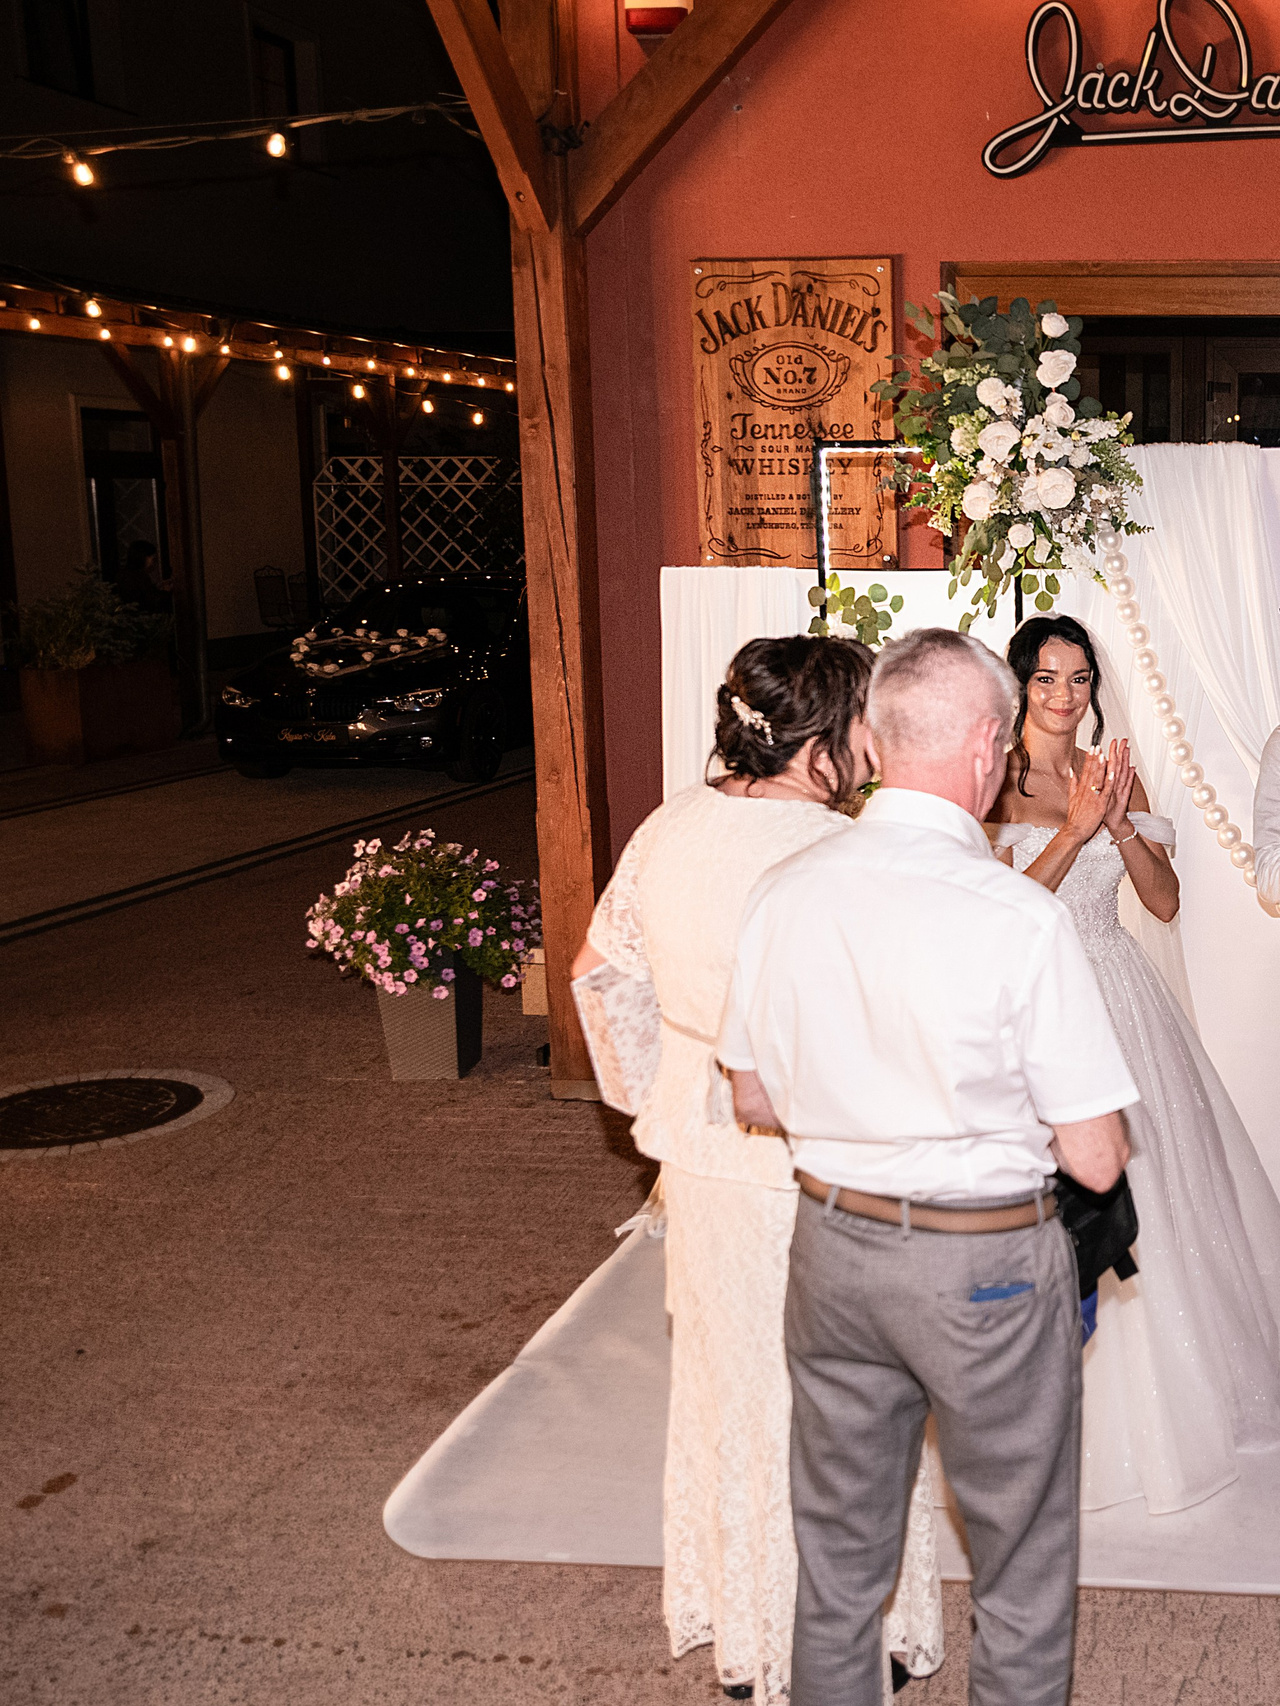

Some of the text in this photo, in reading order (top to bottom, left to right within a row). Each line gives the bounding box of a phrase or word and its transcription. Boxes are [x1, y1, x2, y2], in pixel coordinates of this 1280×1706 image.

[982, 0, 1168, 176] Jack
[694, 281, 889, 355] JACK DANIEL'S
[776, 355, 804, 365] Old
[730, 412, 855, 440] Tennessee
[760, 445, 790, 453] SOUR
[727, 507, 755, 515] JACK
[757, 507, 797, 515] DANIEL
